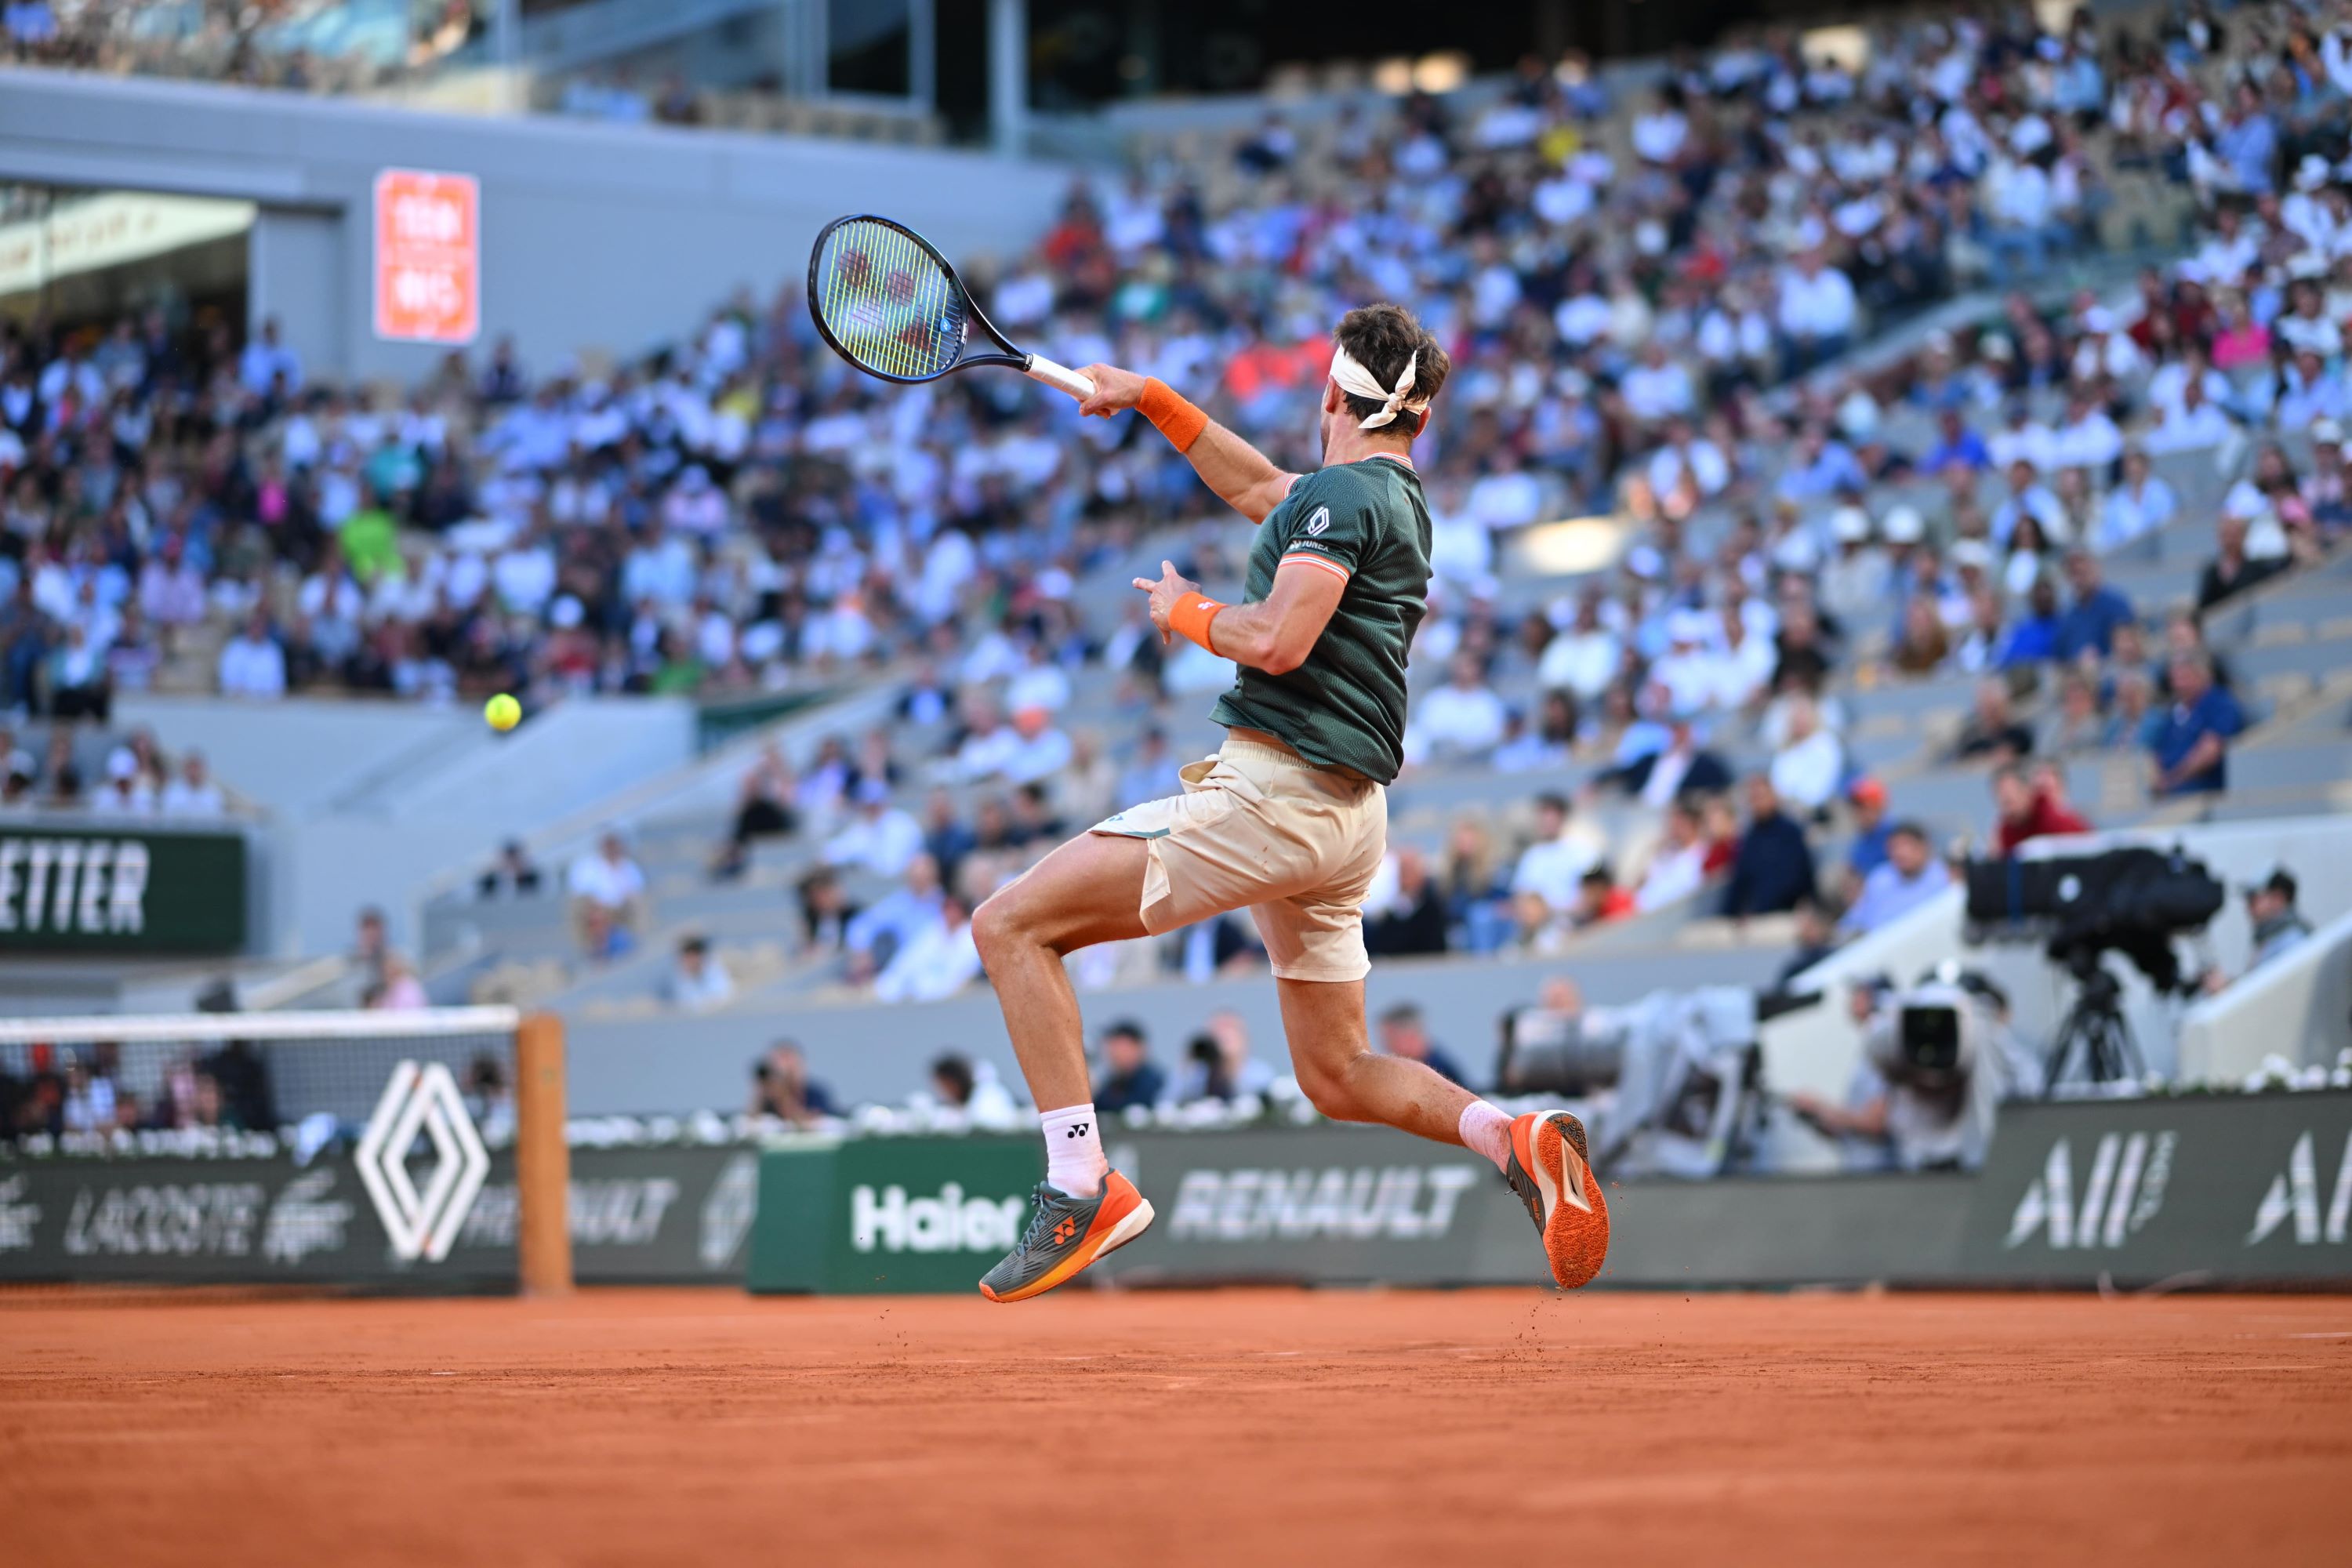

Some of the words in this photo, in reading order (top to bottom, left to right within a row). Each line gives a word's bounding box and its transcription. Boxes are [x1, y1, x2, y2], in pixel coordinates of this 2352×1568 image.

[0, 838, 151, 934] ETTER
[852, 1182, 1025, 1253] Haier
[1169, 1166, 1477, 1240] RENAULT
